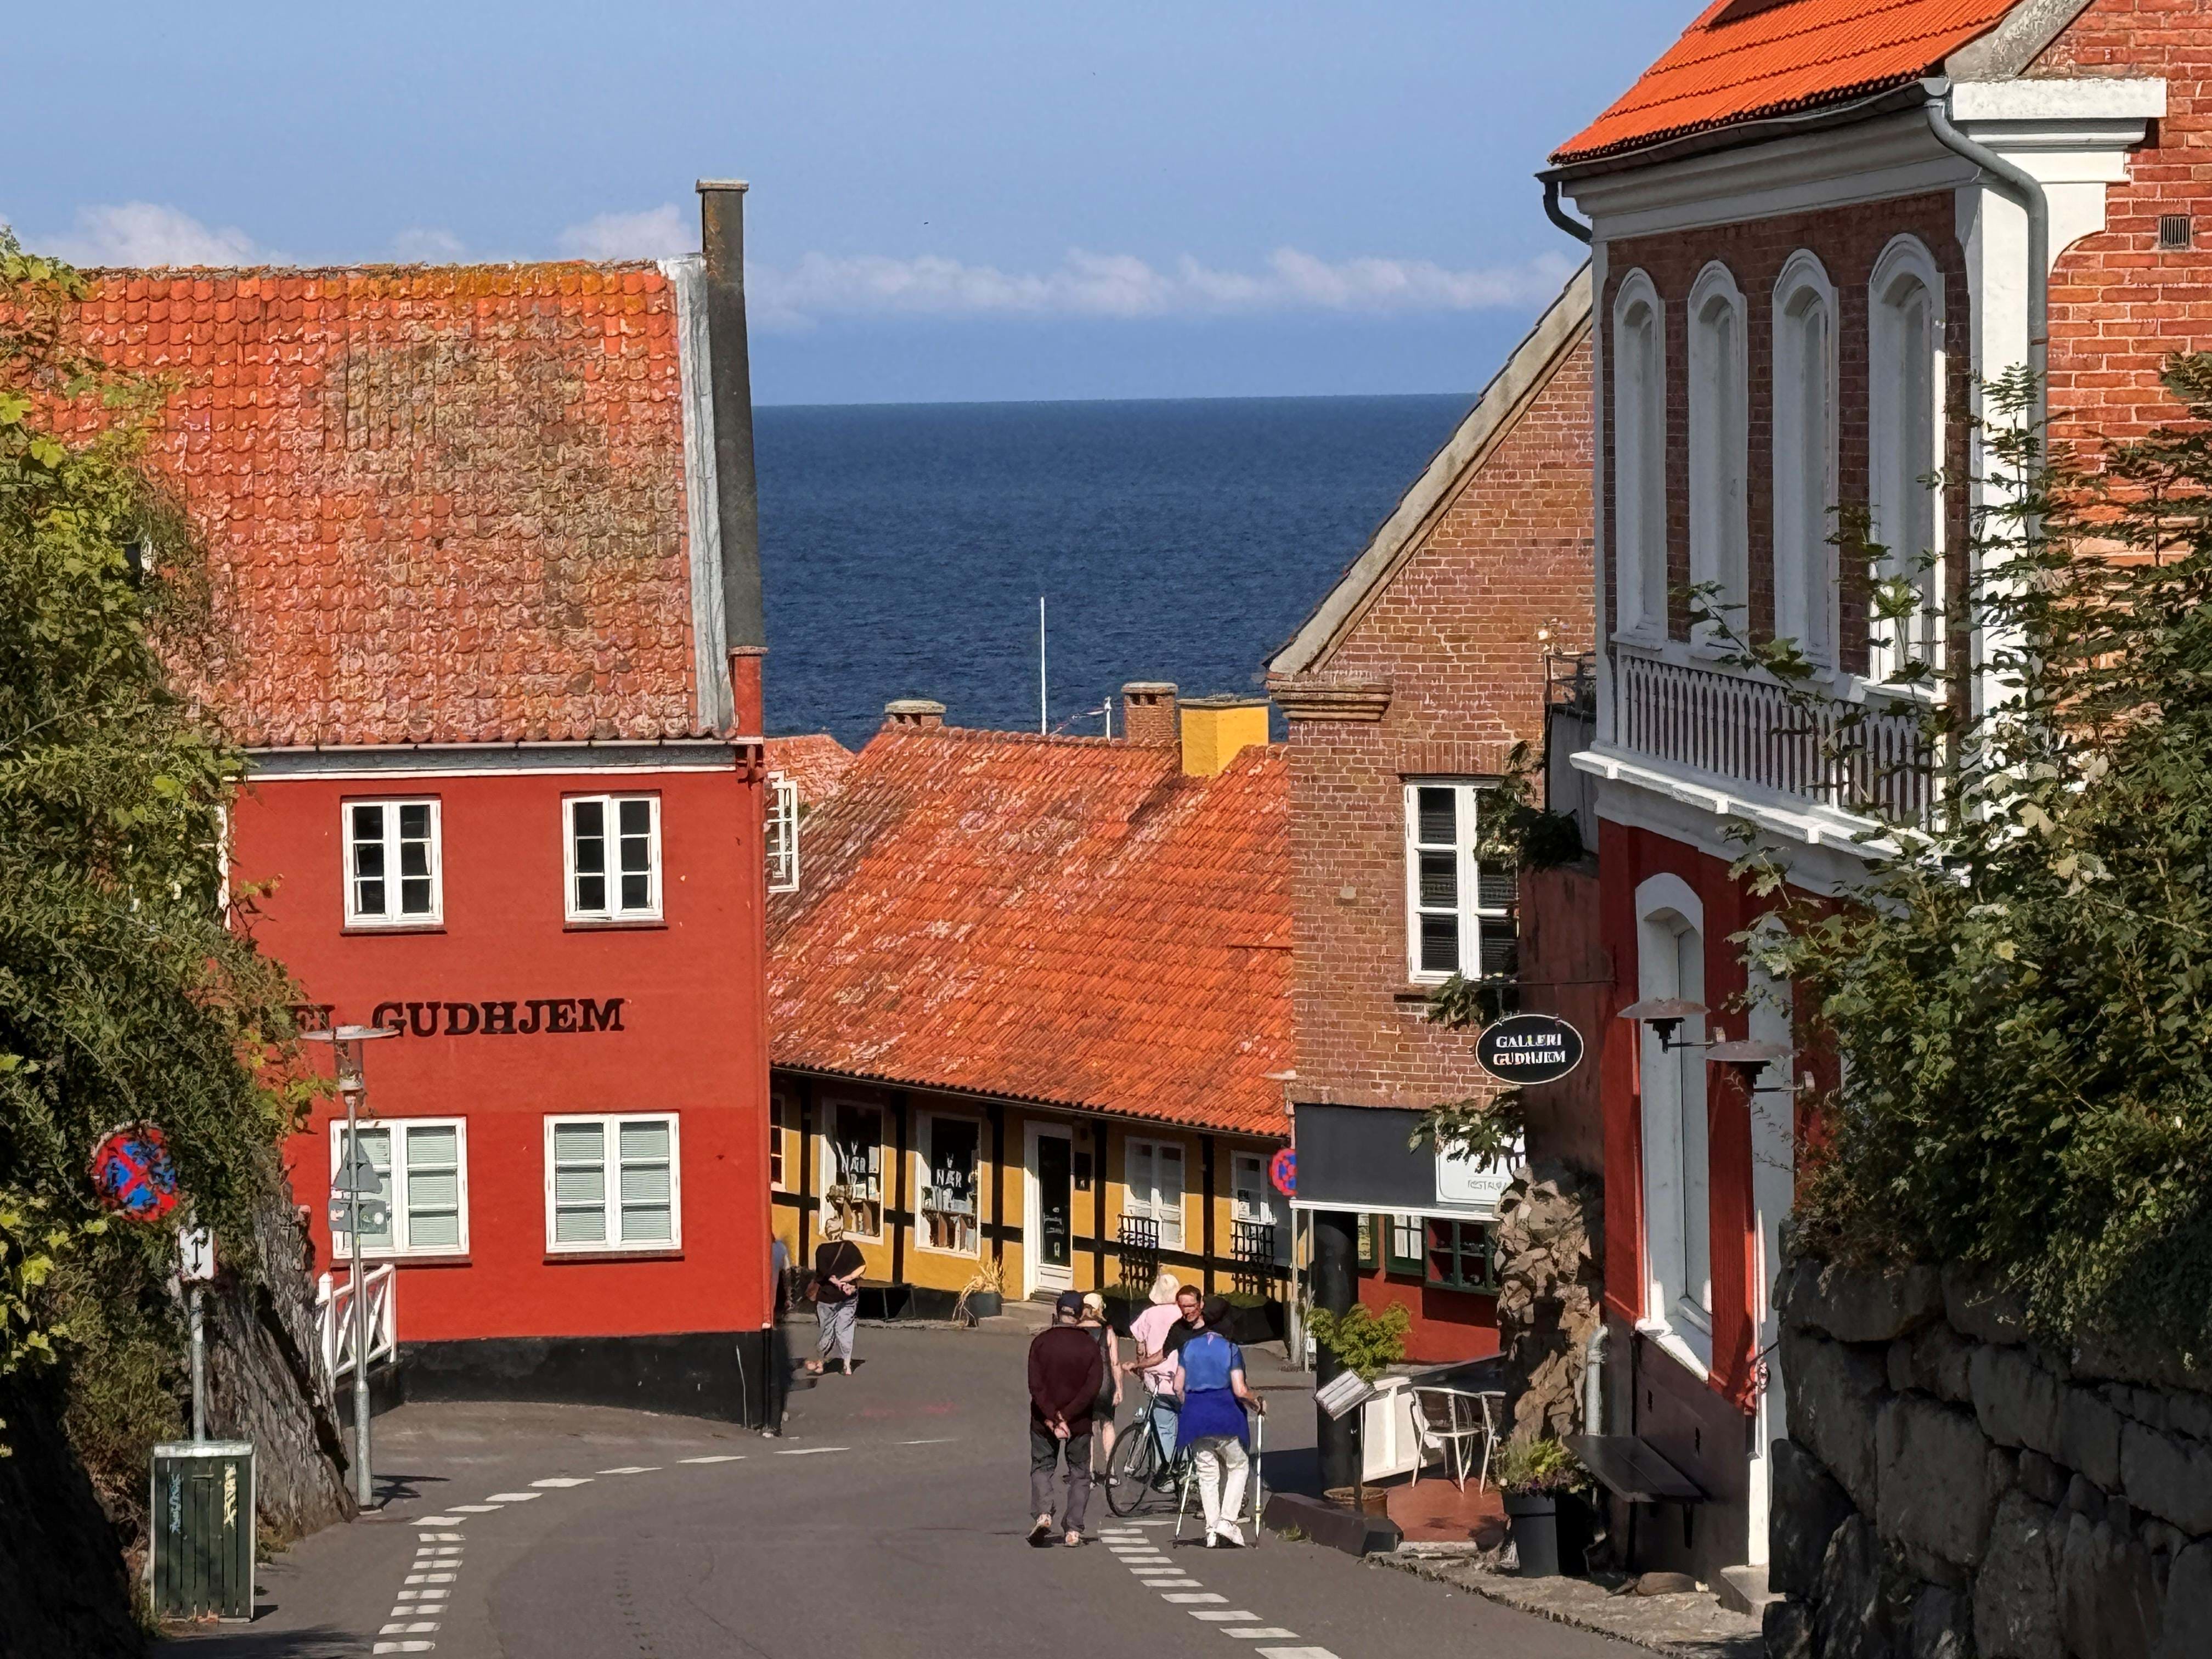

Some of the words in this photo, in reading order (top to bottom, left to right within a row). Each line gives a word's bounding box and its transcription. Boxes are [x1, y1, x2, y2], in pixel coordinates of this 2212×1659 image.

[372, 998, 625, 1037] GUDHJEM
[1496, 1034, 1562, 1048] GALLERI
[1493, 1051, 1566, 1065] GUDHJEM
